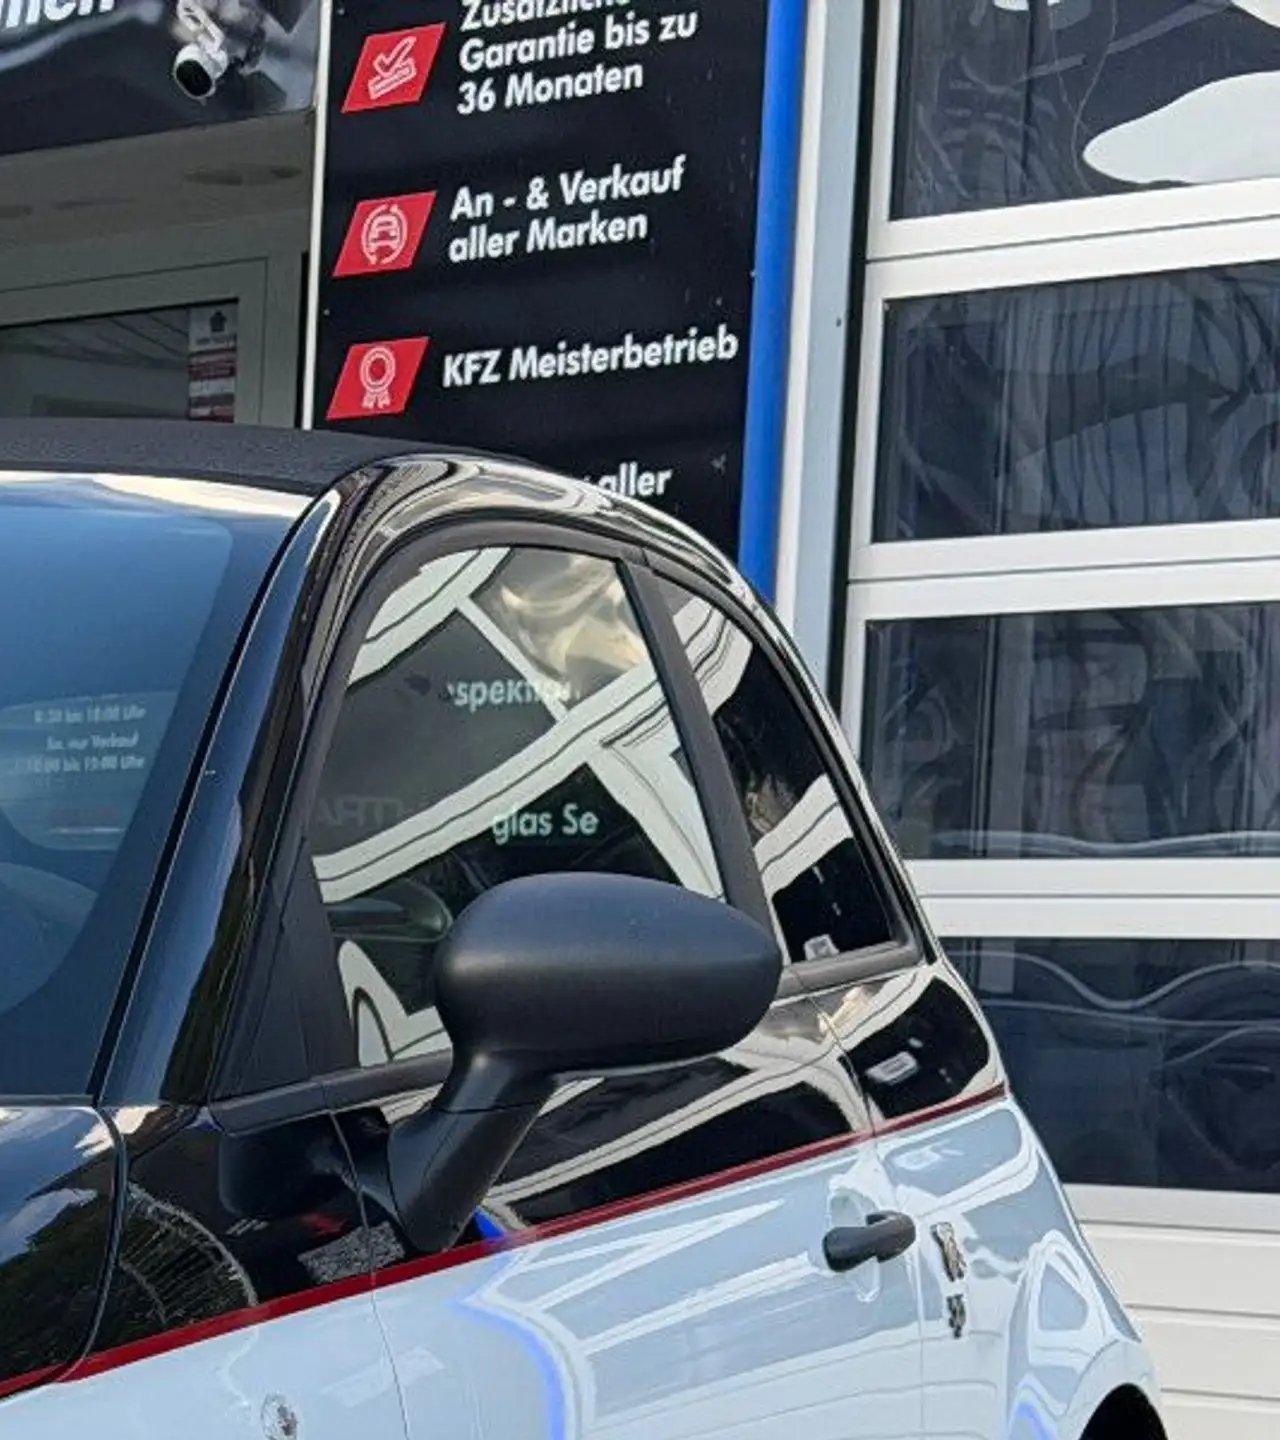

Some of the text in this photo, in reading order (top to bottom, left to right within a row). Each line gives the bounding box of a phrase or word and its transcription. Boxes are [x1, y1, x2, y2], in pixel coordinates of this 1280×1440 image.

[459, 11, 698, 72] Garantie bis zu
[456, 62, 643, 115] 36 Monaten
[450, 186, 494, 221] An
[526, 176, 550, 210] &
[559, 154, 686, 205] Verkauf
[449, 209, 648, 263] aller Marken
[442, 324, 739, 388] KFZ Meisterbetrieb
[599, 461, 673, 497] aller
